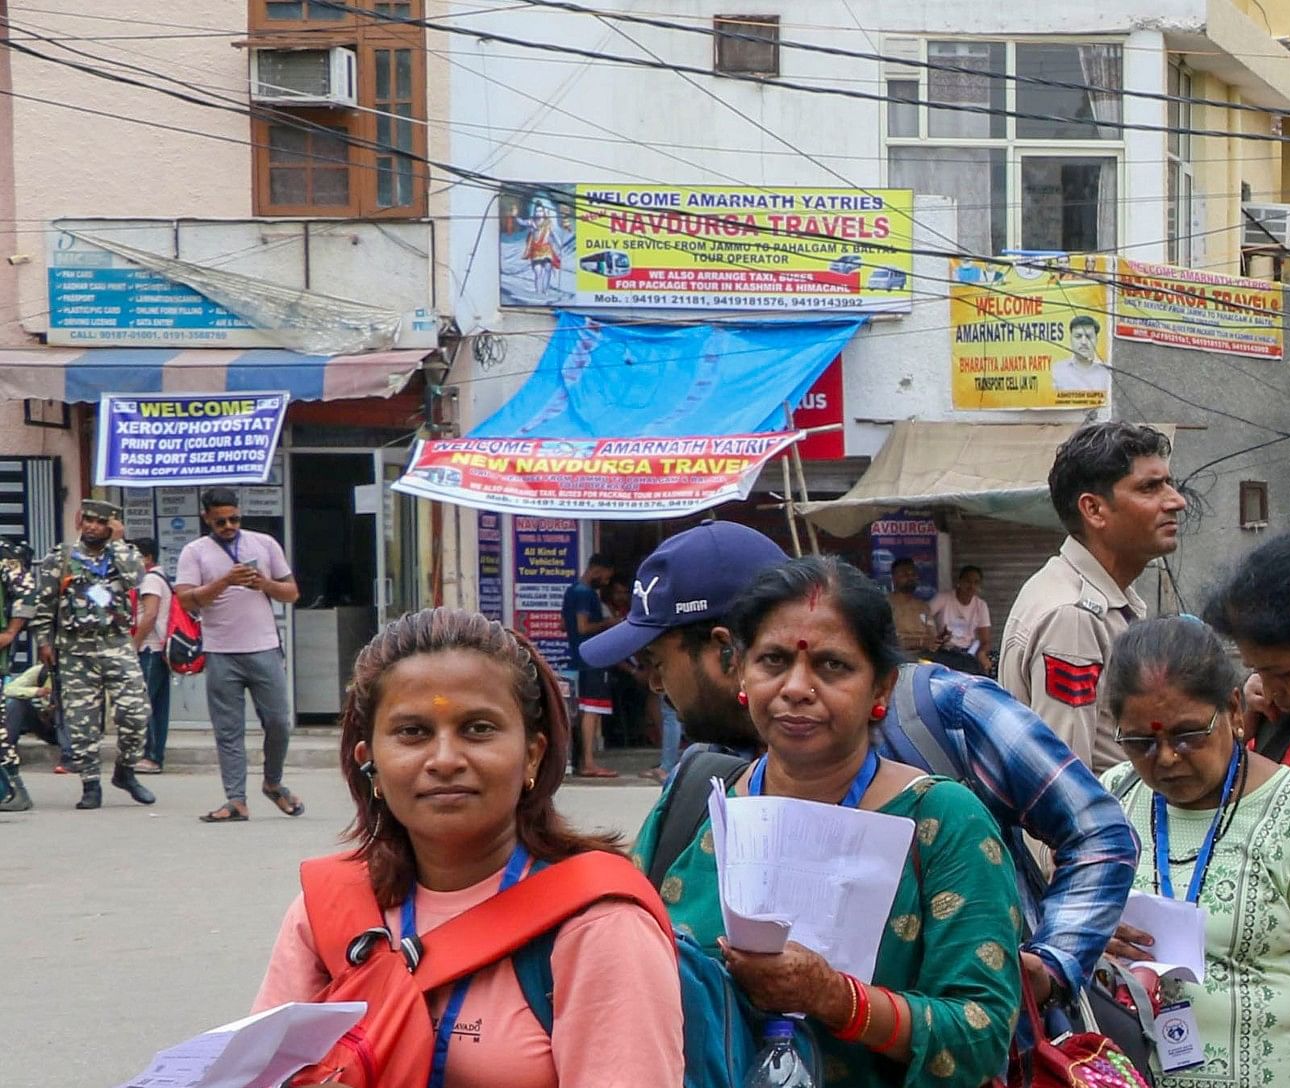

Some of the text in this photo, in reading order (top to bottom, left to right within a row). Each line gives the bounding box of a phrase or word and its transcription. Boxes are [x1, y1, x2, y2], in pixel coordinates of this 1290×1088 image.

[586, 191, 884, 210] WELCOME AMARNATH YATRIES
[609, 211, 890, 239] NAVDURGA TRAVELS
[585, 239, 619, 250] DAILY
[622, 240, 671, 250] SERVICE
[674, 241, 707, 251] FROM
[774, 242, 837, 252] PAHALGAM
[693, 253, 789, 264] TOUR OPERATOR
[649, 271, 668, 280] WE
[670, 271, 694, 280] ALSO
[697, 271, 747, 281] ARRANGE
[749, 272, 778, 282] TAXI,
[615, 280, 794, 292] FOR PACKAGE TOUR IN KASHMIR &
[1120, 274, 1208, 309] NAVDURGA
[594, 294, 863, 307] Mob. 94191 21181, 9419181576, 9419143992
[976, 296, 1044, 317] WELCOME
[955, 321, 1065, 344] AMARNATH YATRIES
[959, 355, 1053, 373] BHARATIYA JANATA PARTY
[974, 376, 1005, 392] TRANSPORT
[1005, 376, 1019, 391] CELL
[140, 400, 255, 417] WELCOME
[116, 417, 274, 435] XEROX/PHOTOSTAT
[121, 438, 157, 450] PRINT
[158, 438, 183, 450] OUT
[184, 436, 233, 451] (COLOUR
[233, 435, 243, 446] &
[434, 441, 534, 454] WELCOME
[600, 440, 706, 456] AMARNATH
[120, 450, 266, 465] PASS PORT SIZE PHOTOS
[451, 453, 509, 472] NEW
[515, 459, 652, 475] NAVDURGA
[120, 464, 265, 476] SCAN COPY AVAILABLE HERE
[675, 599, 708, 614] PUMA
